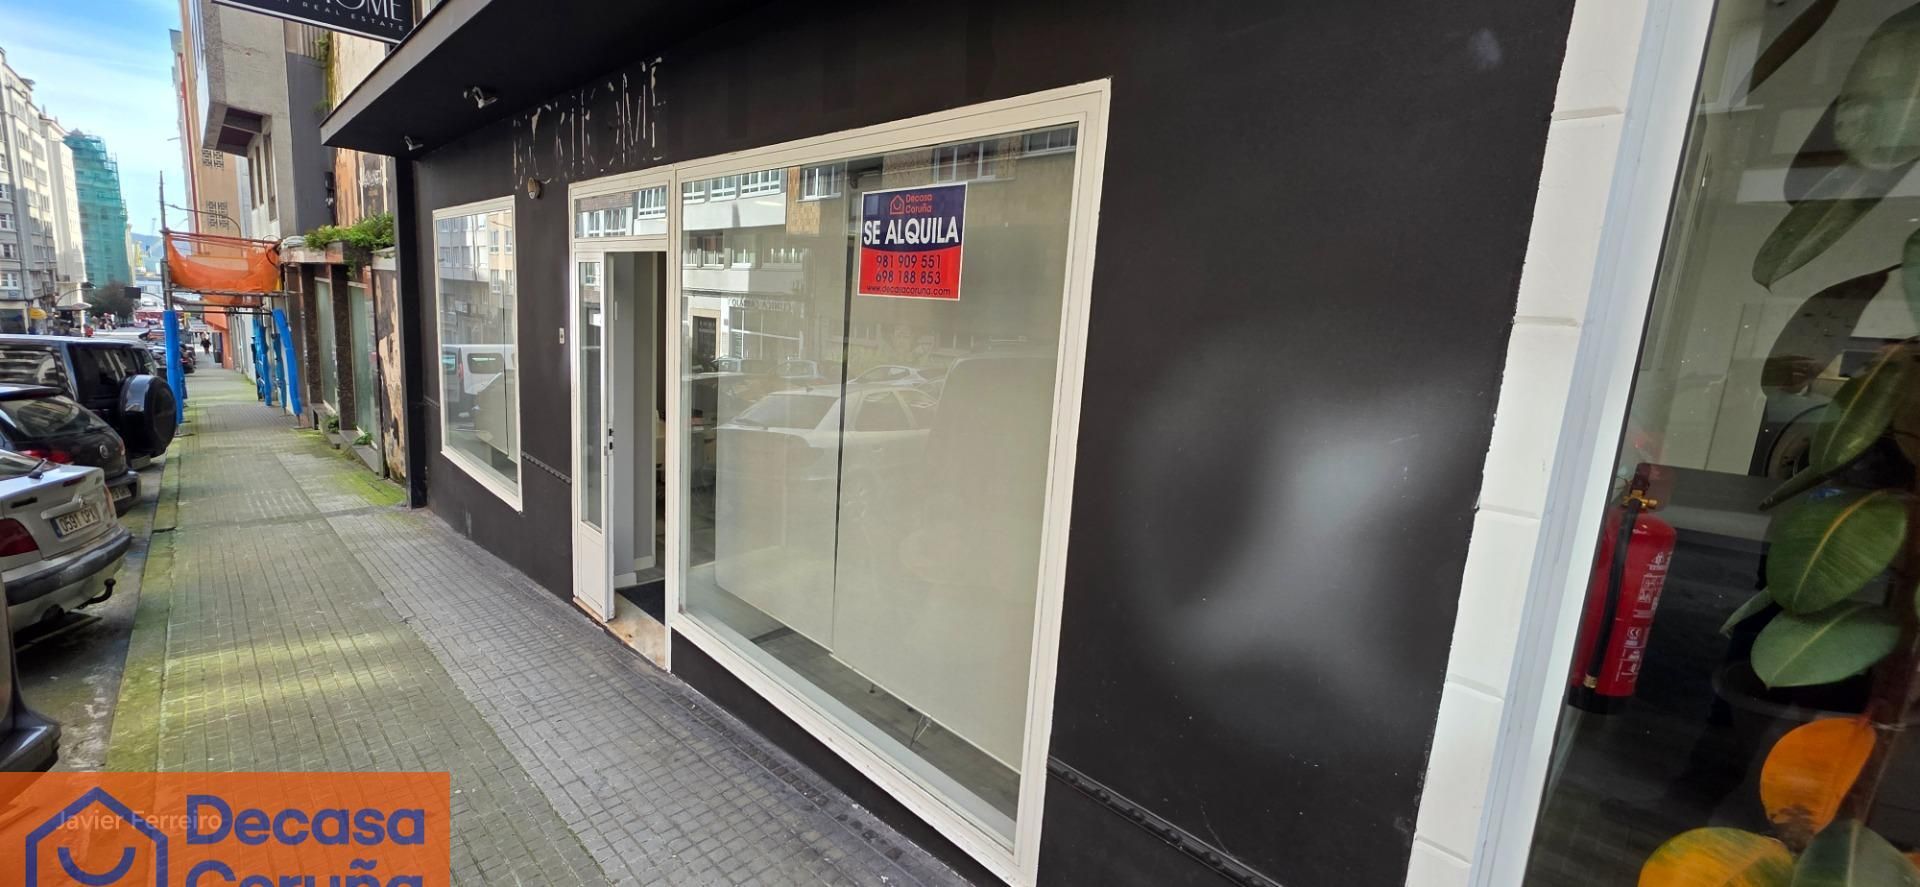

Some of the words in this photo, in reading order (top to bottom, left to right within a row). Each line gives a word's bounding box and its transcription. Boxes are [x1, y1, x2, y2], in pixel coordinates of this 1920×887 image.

[303, 2, 339, 15] REAL
[351, 14, 403, 31] ESTATE
[906, 194, 932, 203] Decasa
[906, 203, 932, 213] Coruña
[864, 220, 881, 245] SE
[885, 216, 959, 245] ALQUILA
[876, 255, 893, 268] 981
[898, 255, 917, 268] 909
[921, 255, 941, 269] 551
[876, 270, 893, 283] 698
[898, 270, 916, 284] 188
[920, 271, 941, 285] 853
